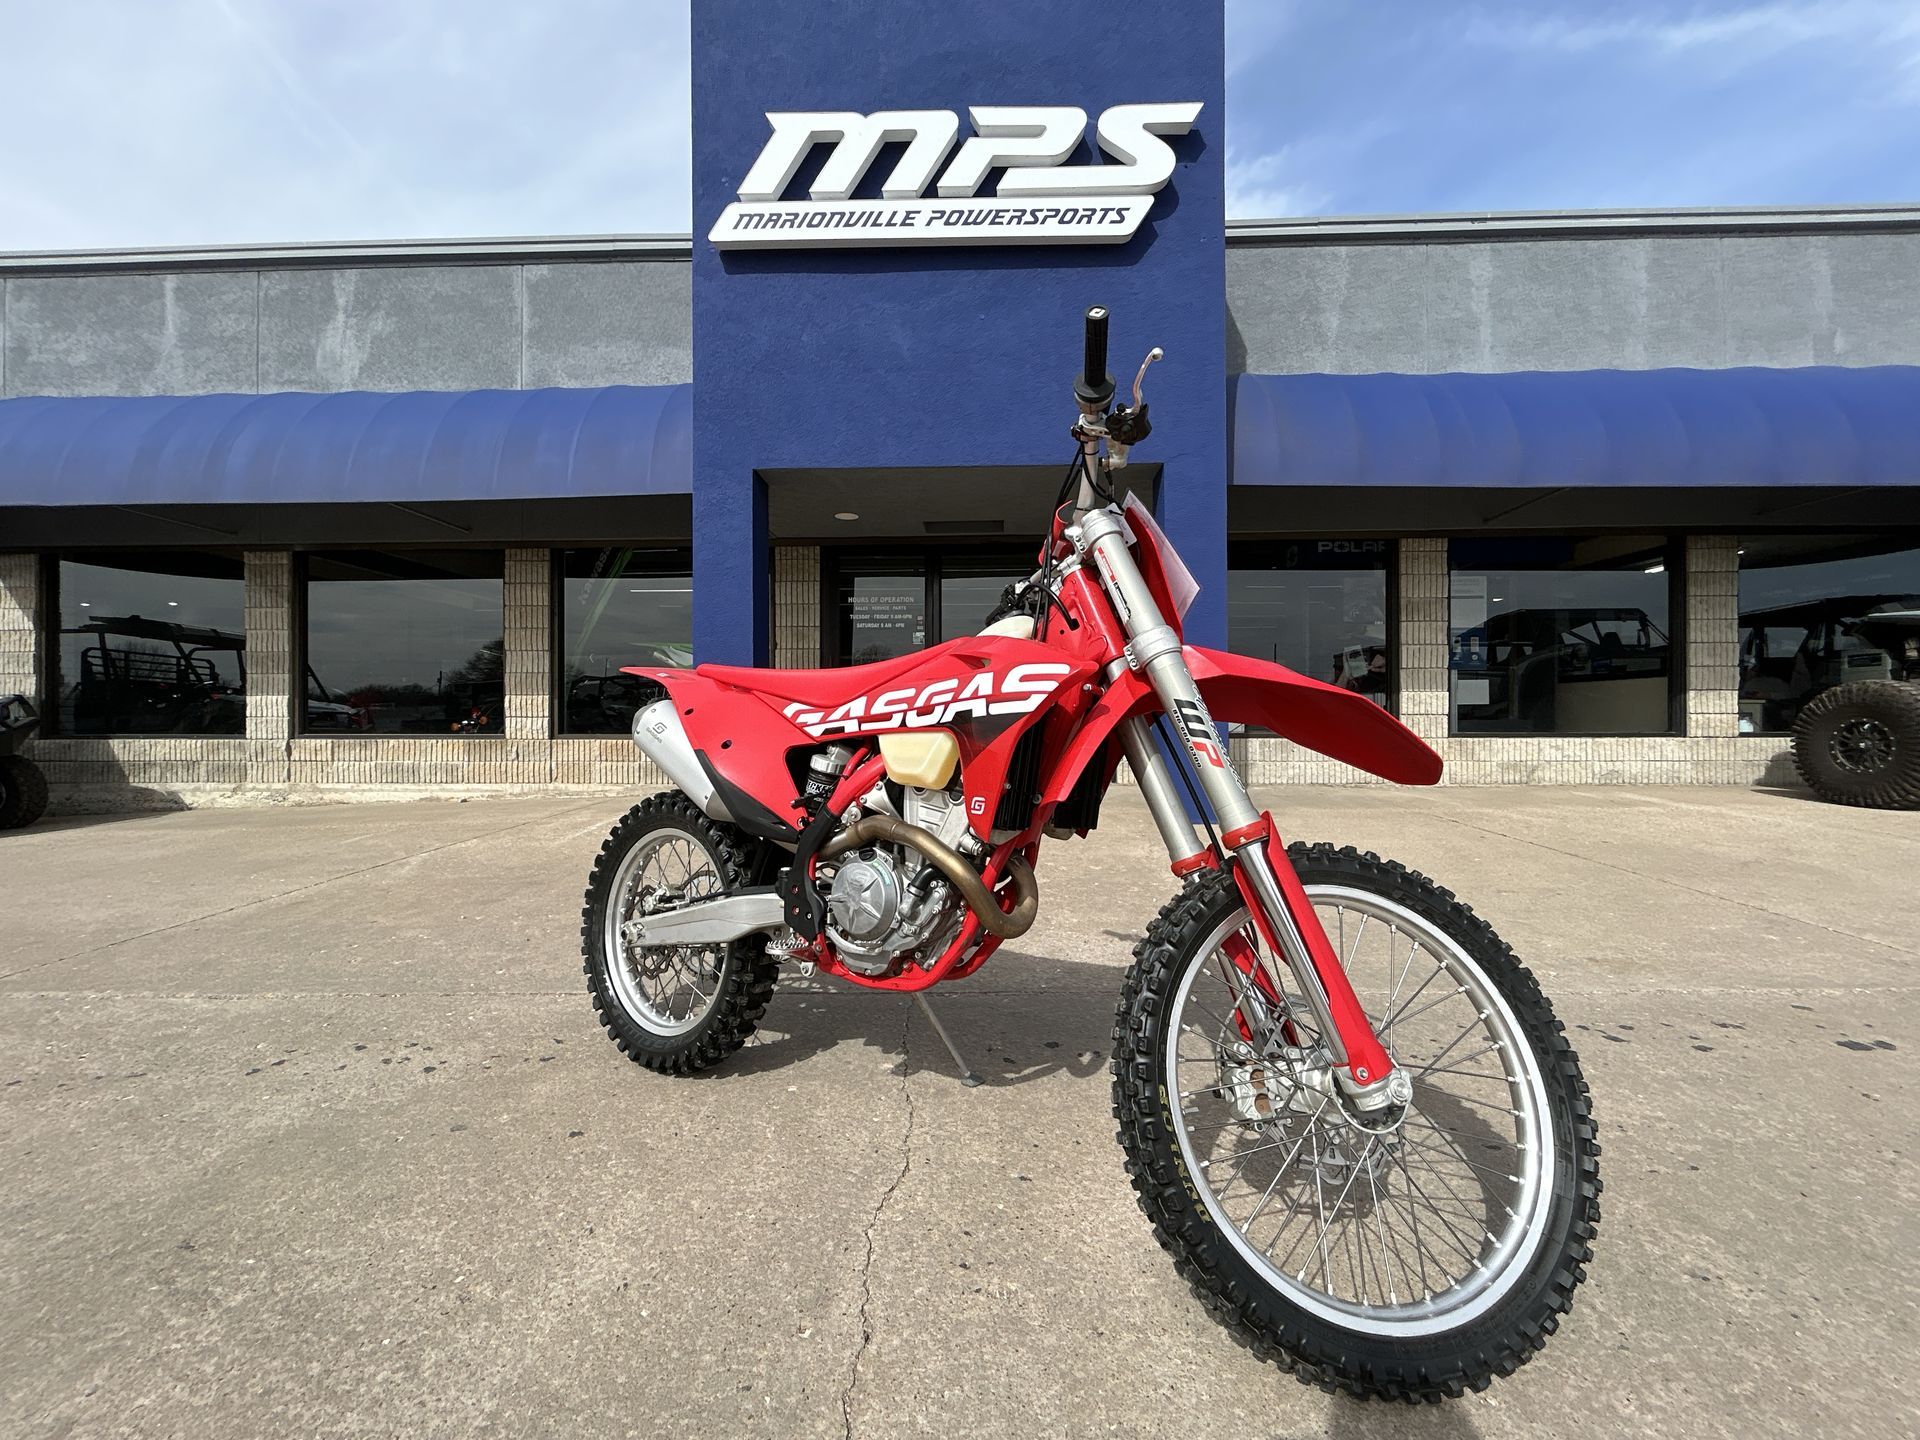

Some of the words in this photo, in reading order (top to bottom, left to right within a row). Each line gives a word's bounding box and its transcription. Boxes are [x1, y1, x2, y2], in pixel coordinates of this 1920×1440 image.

[735, 102, 1204, 200] MPS
[733, 209, 922, 230] MARIONVILLE
[925, 206, 1132, 228] POWERSPORTS
[782, 663, 1071, 737] GASGAS
[1158, 1083, 1213, 1224] DUNLOP
